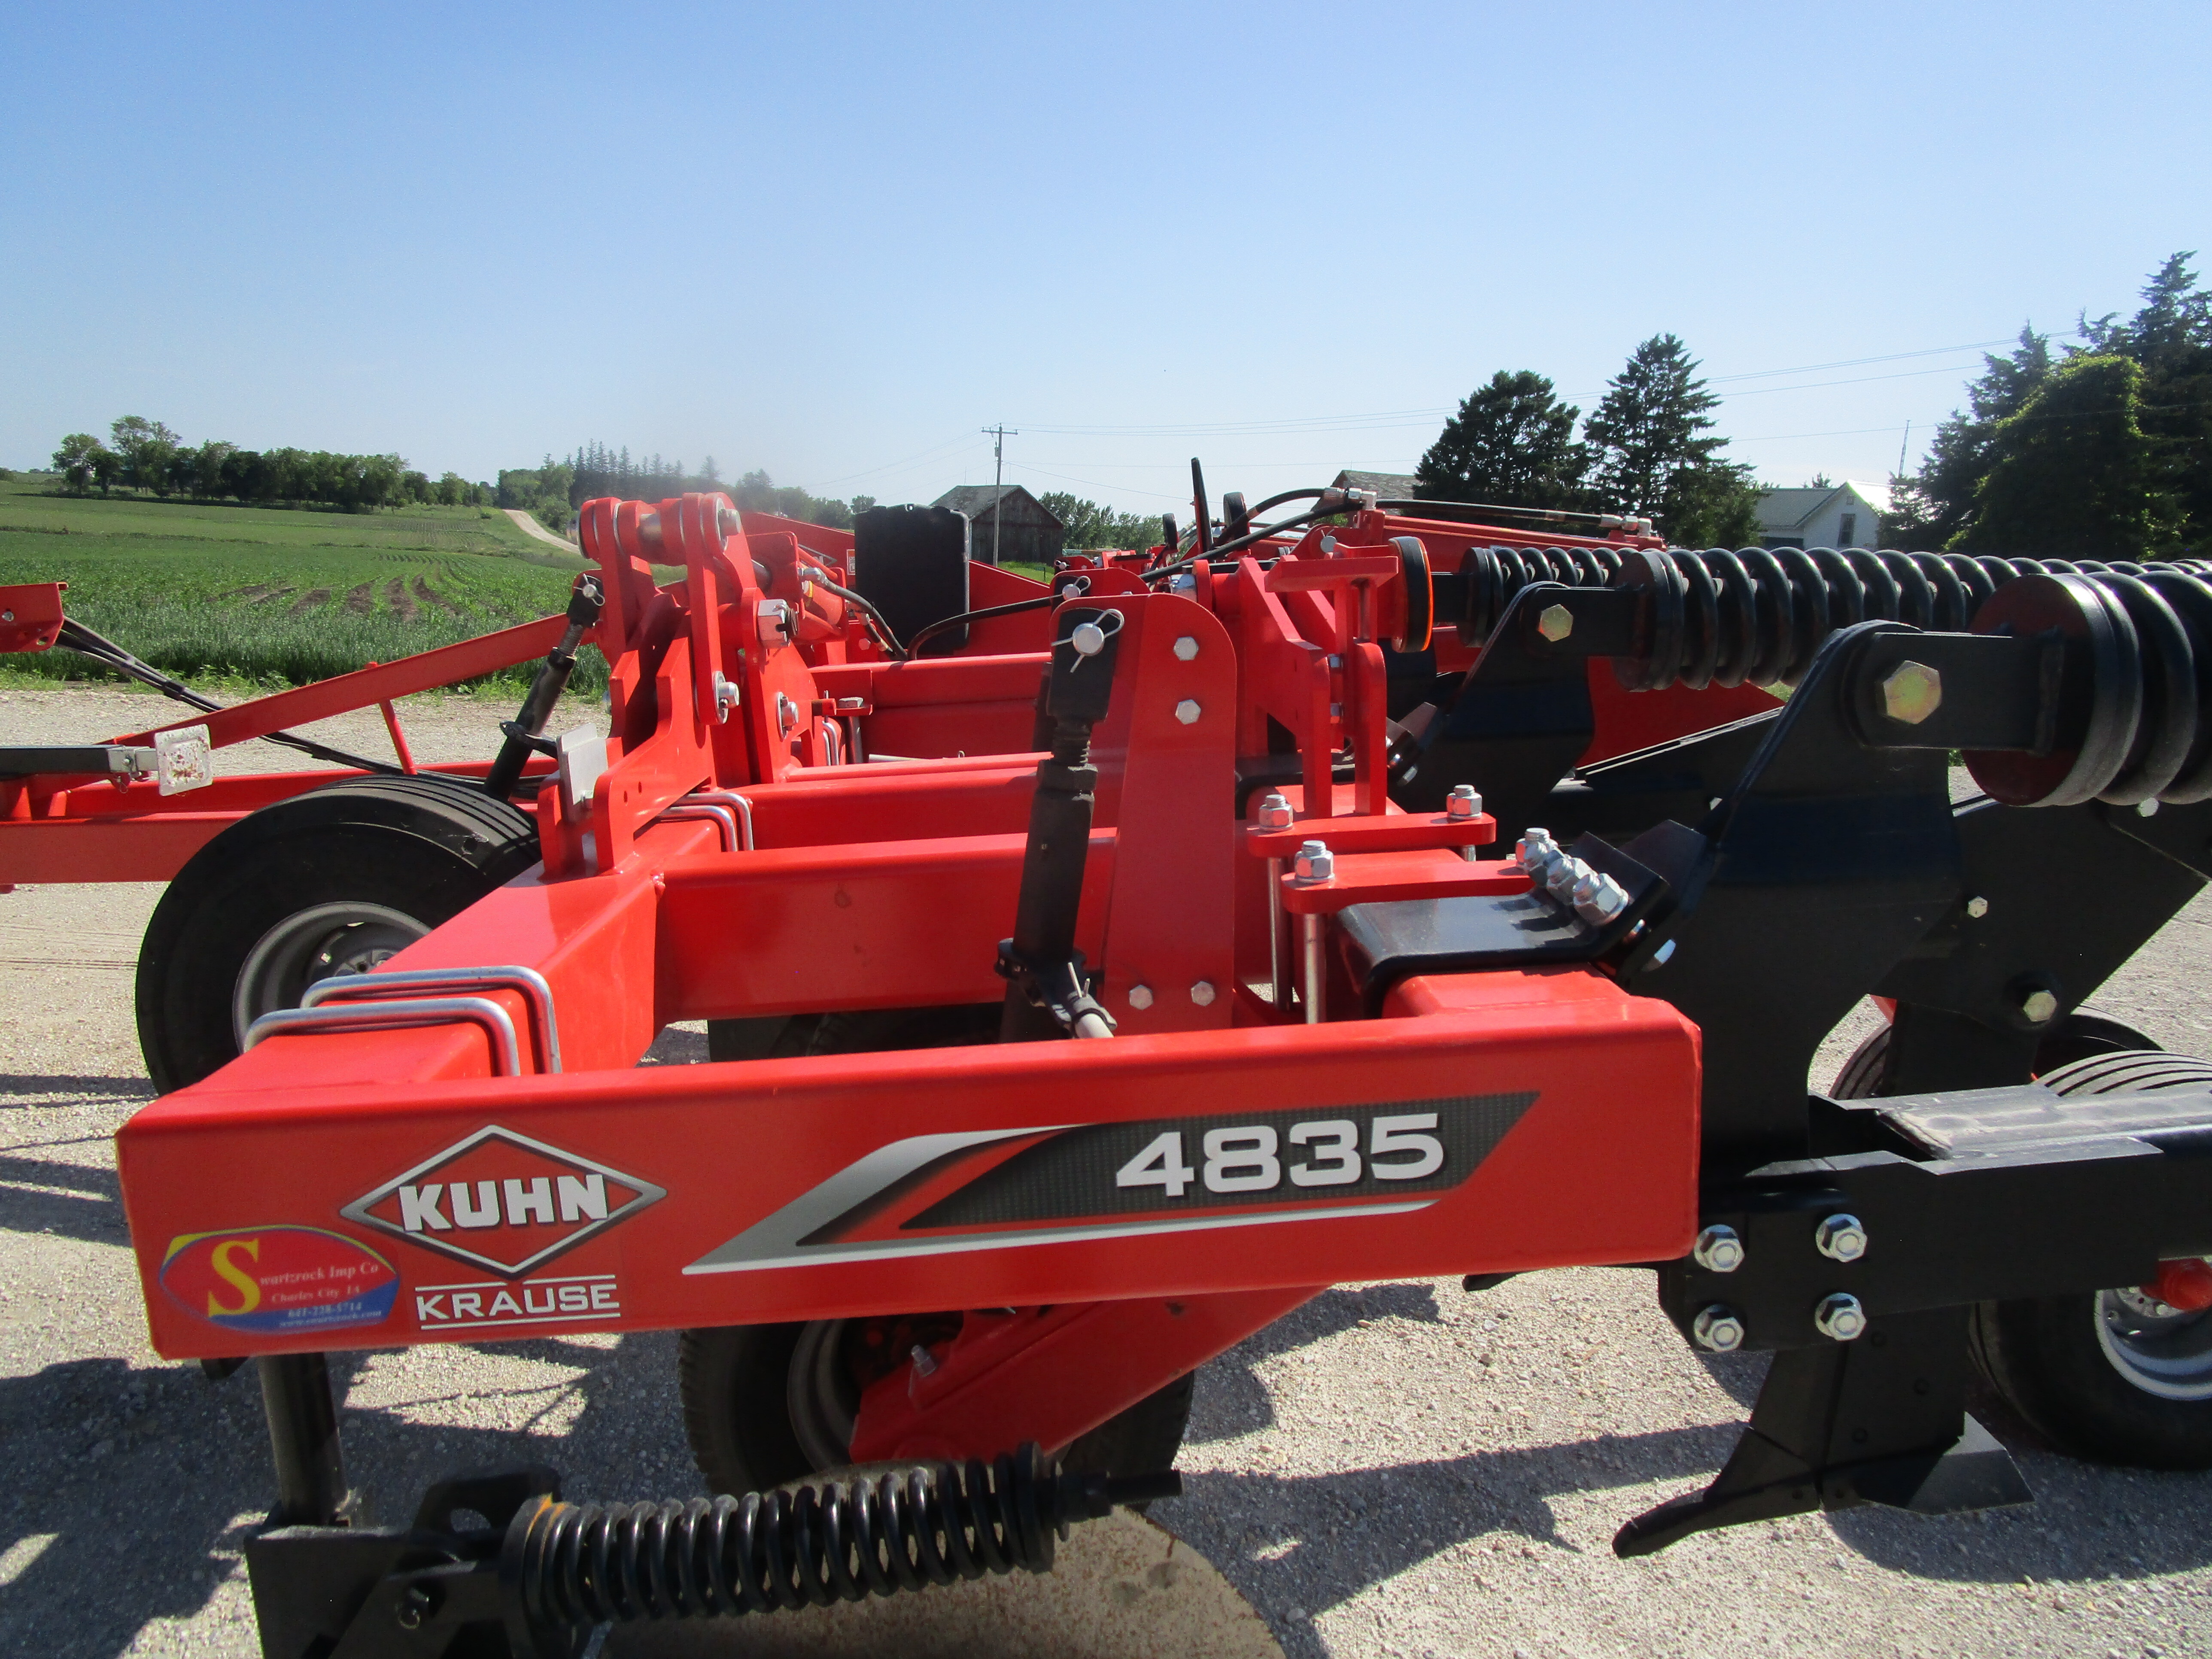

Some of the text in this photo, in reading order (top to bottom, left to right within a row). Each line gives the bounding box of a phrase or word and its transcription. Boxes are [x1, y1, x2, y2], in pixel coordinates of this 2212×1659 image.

[1116, 1113, 1444, 1197] 4835
[399, 1174, 608, 1231] KUHN
[416, 1284, 620, 1321] KRAUSE
